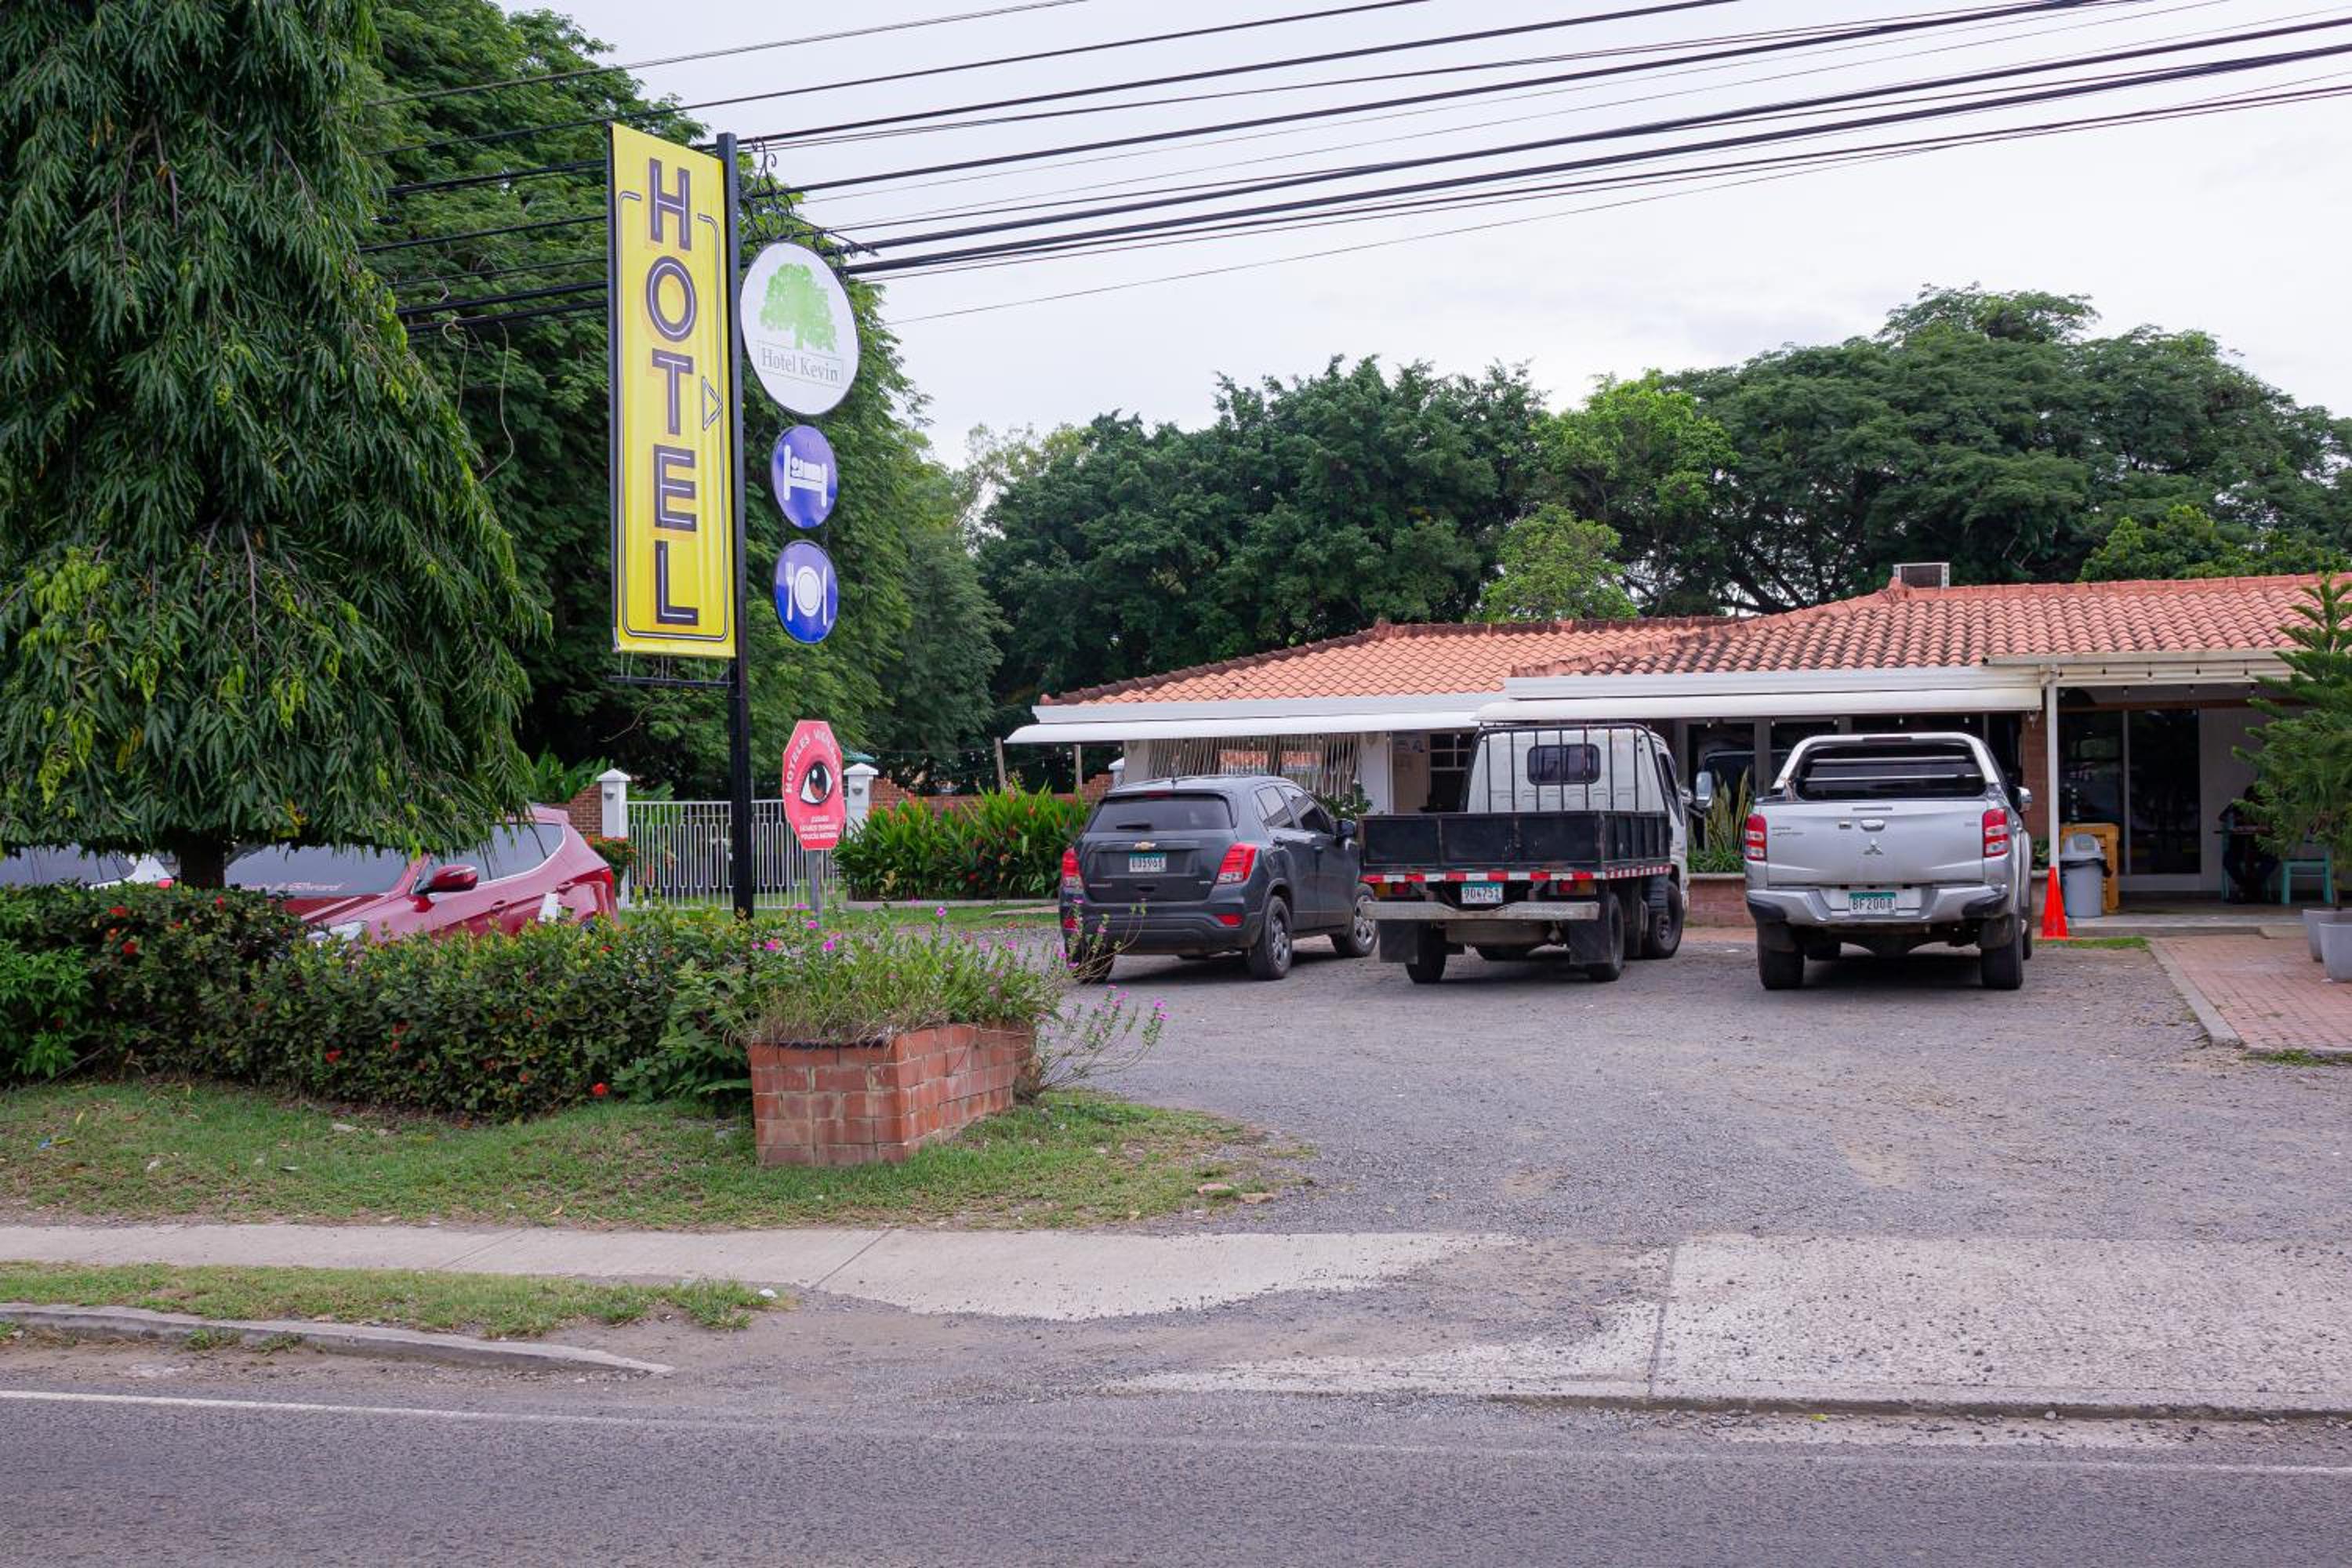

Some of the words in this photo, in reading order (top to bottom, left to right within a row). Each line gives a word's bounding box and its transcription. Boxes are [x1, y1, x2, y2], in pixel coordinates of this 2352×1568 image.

[646, 158, 699, 626] HOTEL
[761, 347, 796, 372] Hotel
[800, 357, 838, 381] Kevin
